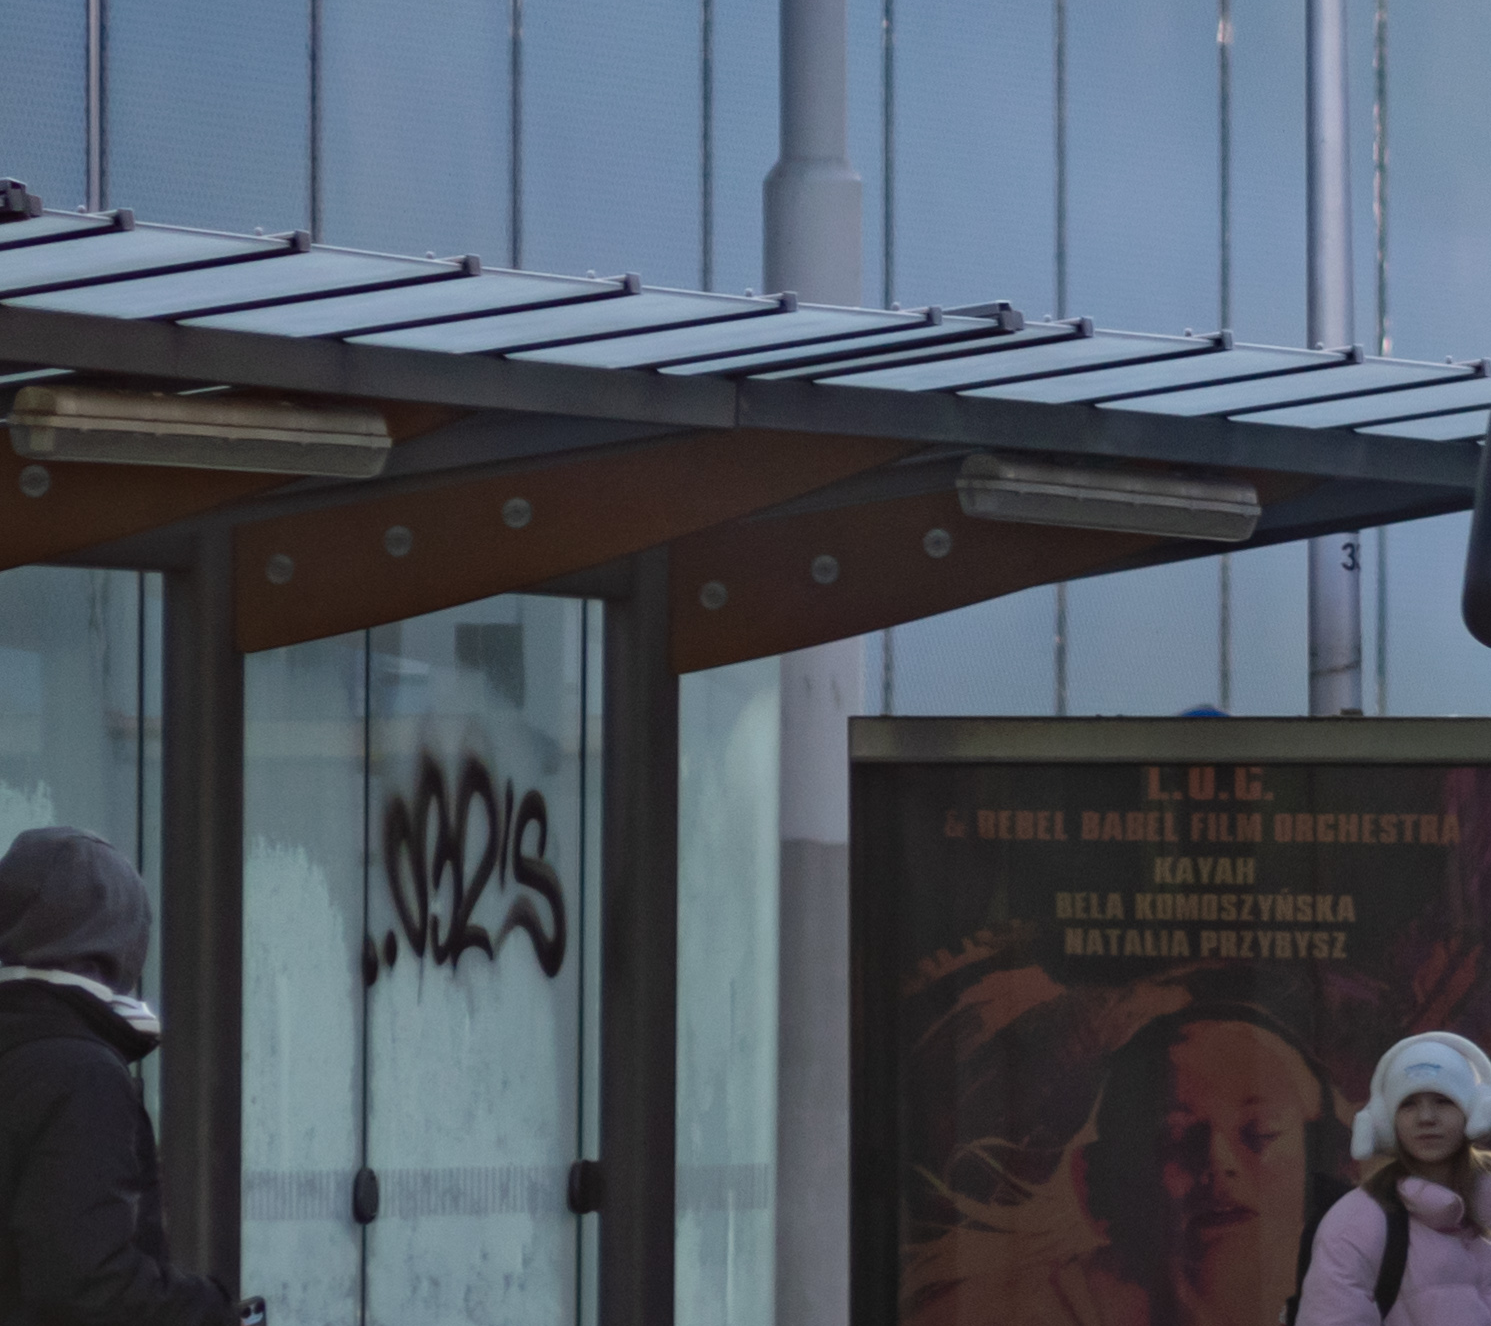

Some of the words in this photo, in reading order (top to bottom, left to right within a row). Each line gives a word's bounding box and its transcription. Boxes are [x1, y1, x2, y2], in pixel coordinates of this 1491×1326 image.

[977, 811, 1068, 841] REBEL
[1081, 812, 1179, 843] BABEL
[1190, 813, 1263, 843] FILM
[1274, 813, 1462, 844] ORCHESTRA
[1153, 856, 1256, 885] KAYAH
[1055, 892, 1125, 920] BELA
[1135, 887, 1357, 922] KOMOSZYŃSKA
[1064, 929, 1190, 958] NATALIA
[1200, 930, 1349, 960] PRZYBYSZ
